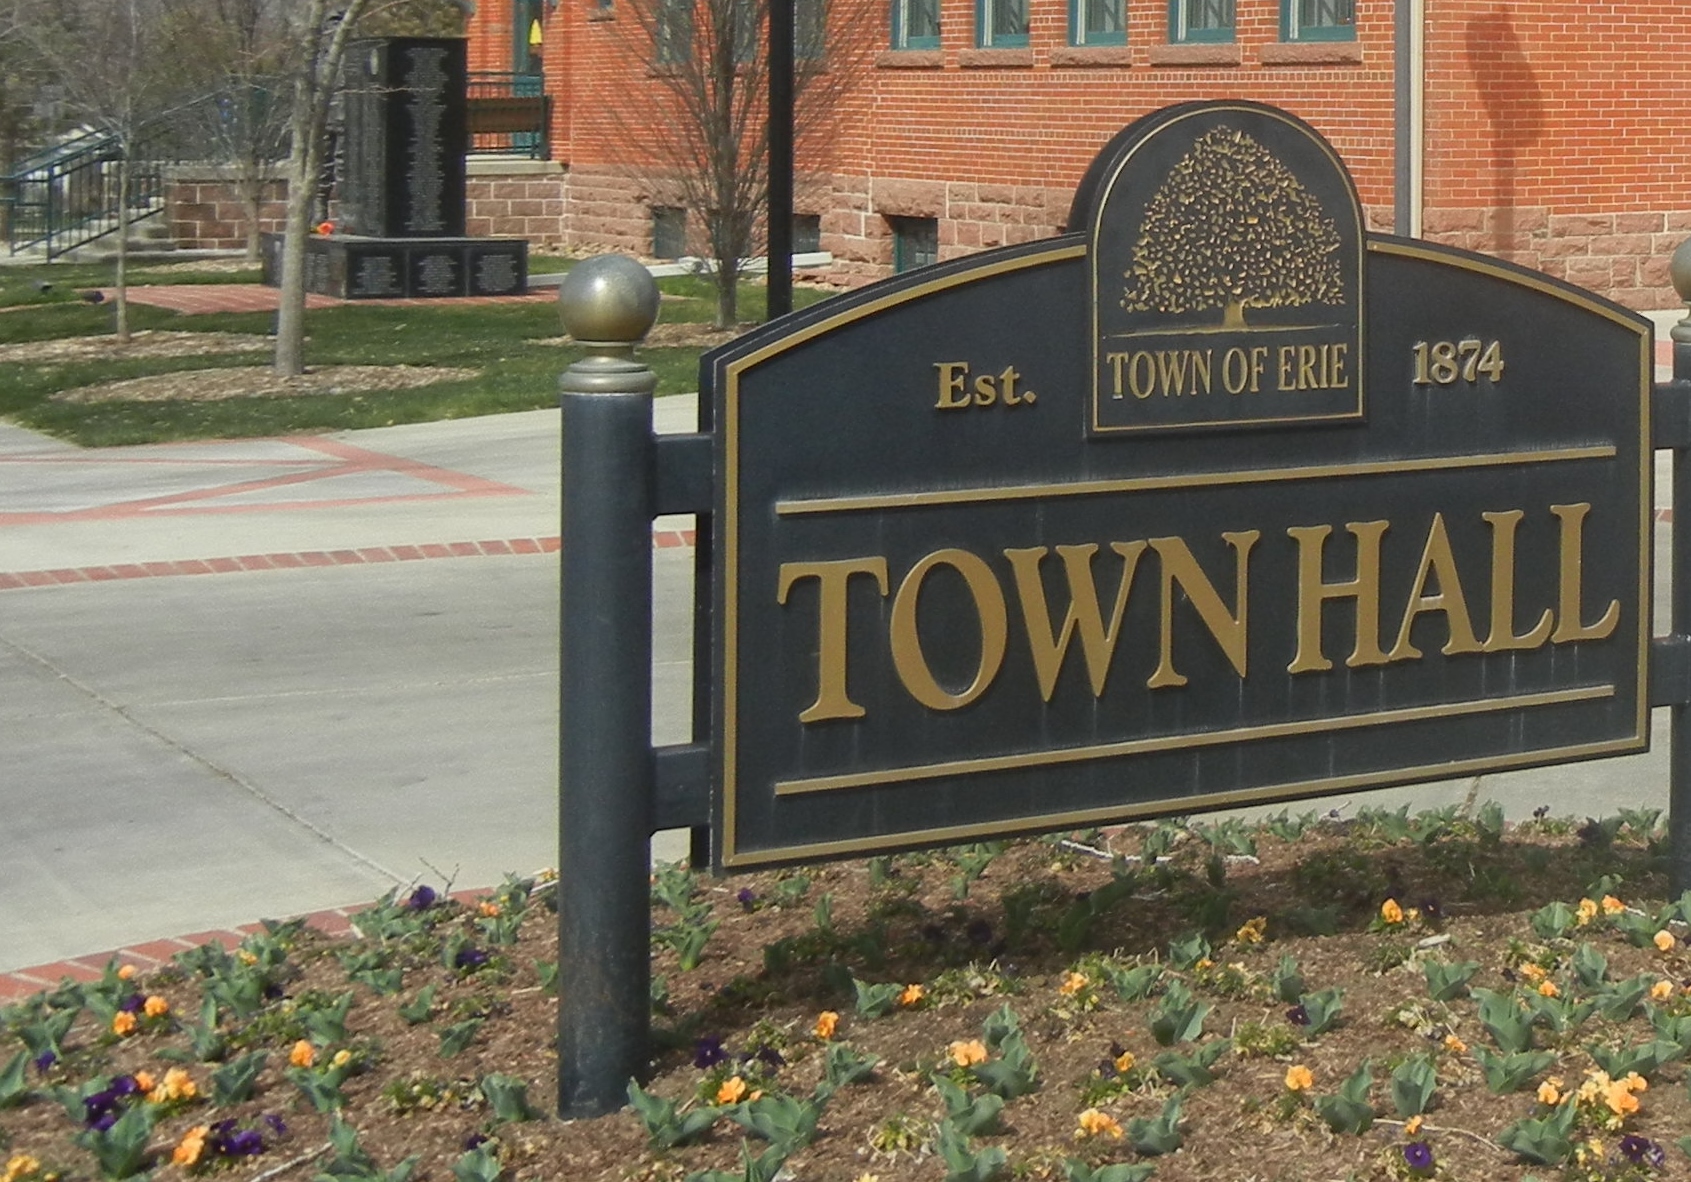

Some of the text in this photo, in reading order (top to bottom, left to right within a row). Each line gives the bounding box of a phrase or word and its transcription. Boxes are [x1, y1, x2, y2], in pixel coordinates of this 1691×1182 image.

[933, 362, 1037, 408] Est.
[1106, 343, 1349, 400] TOWN OF ERIE
[1412, 340, 1505, 384] 1874
[777, 503, 1620, 723] TOWN HALL
